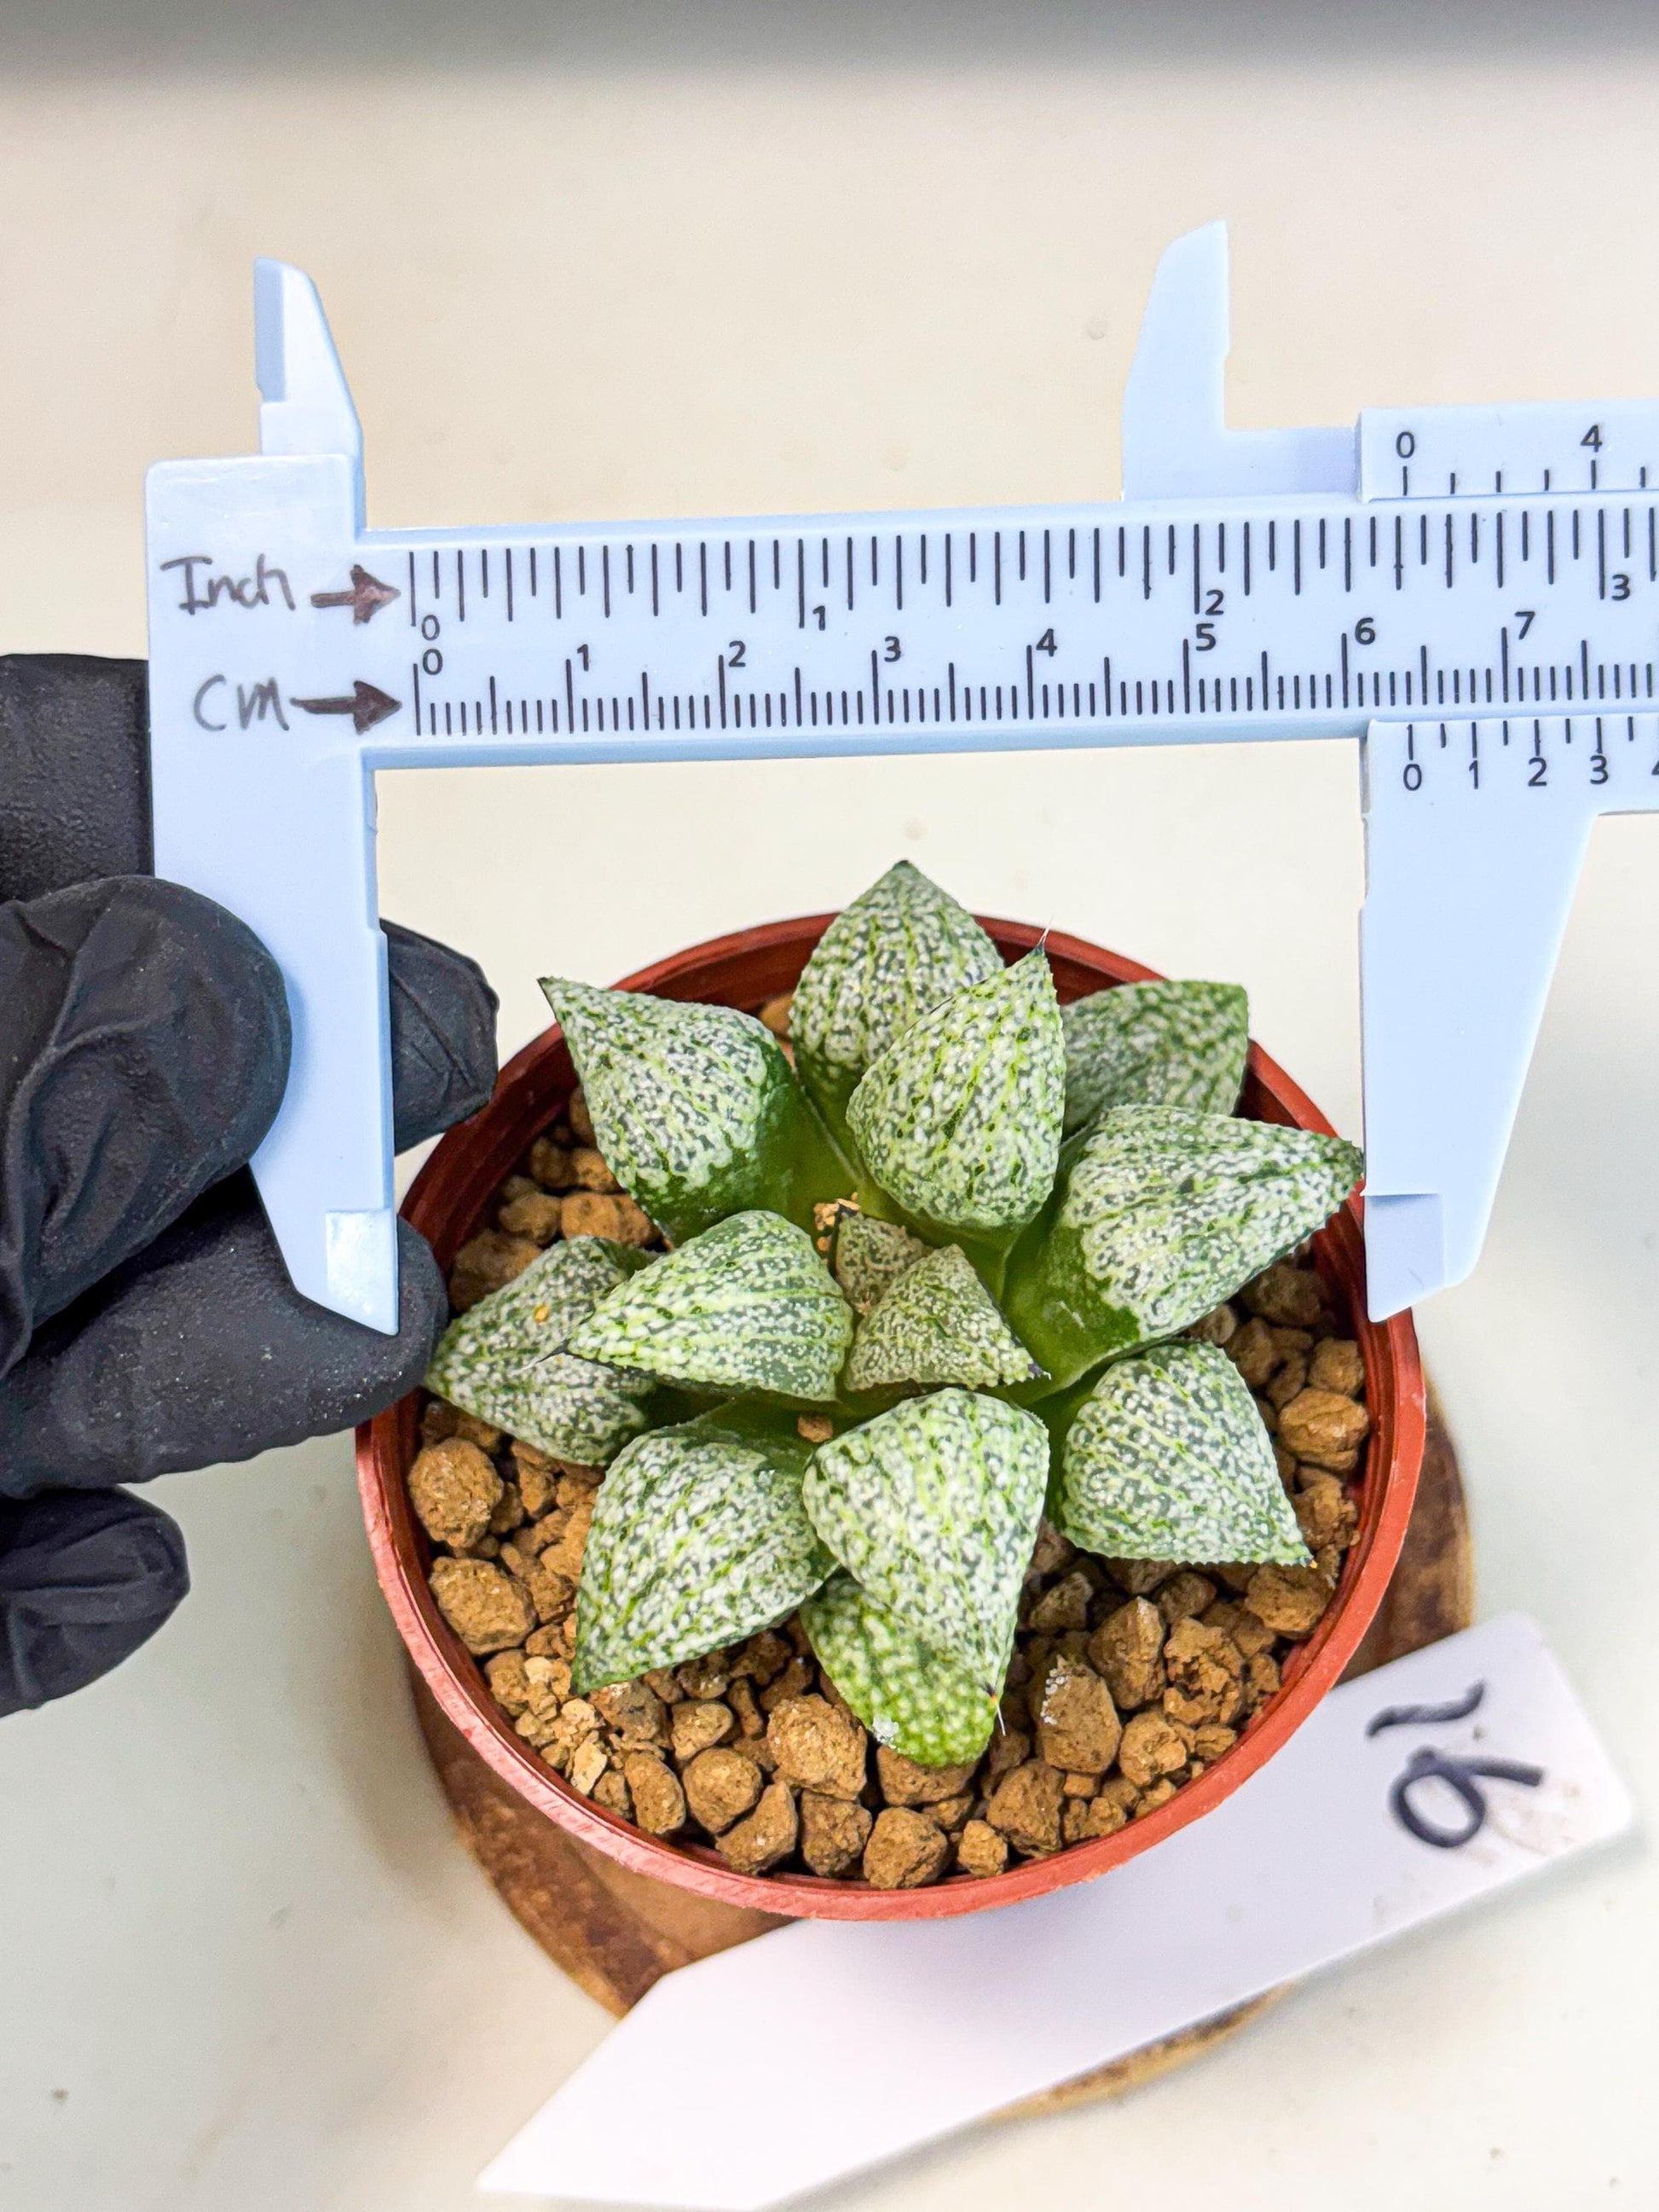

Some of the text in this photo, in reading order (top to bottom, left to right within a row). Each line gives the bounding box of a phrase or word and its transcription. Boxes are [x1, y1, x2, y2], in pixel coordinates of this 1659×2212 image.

[1396, 424, 1604, 459] 0 4
[159, 552, 297, 616] Inch
[421, 574, 1631, 641] 0 1 2 3
[422, 610, 1536, 676] 0 1 2 3 4 5 6 7
[1402, 754, 1610, 792] 0 1 2 3
